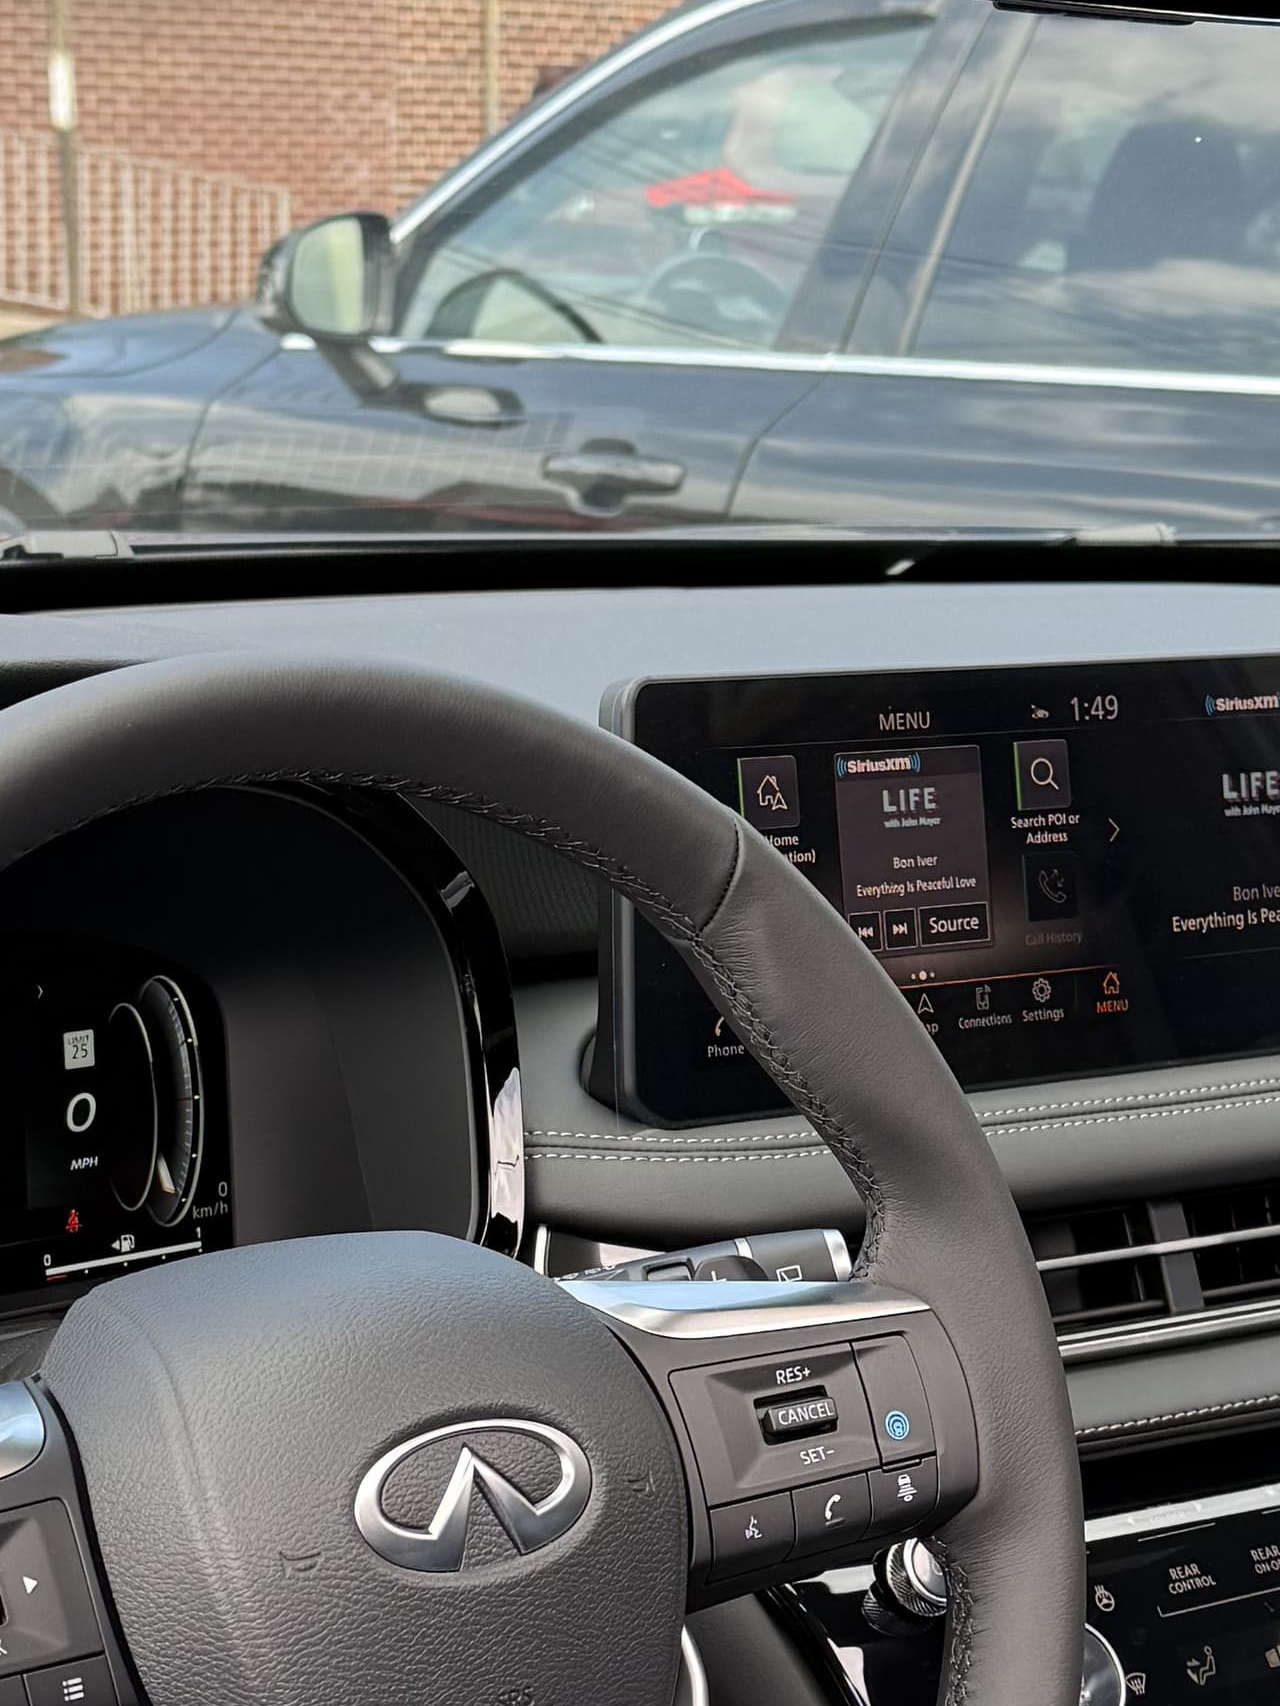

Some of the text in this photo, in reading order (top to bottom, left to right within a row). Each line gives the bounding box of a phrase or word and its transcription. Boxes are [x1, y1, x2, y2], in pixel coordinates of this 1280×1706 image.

[1071, 695, 1119, 722] 1:49
[879, 712, 930, 731] MENU
[883, 788, 936, 813] LIFE
[1224, 806, 1241, 817] with
[1243, 805, 1259, 815] John
[1011, 814, 1080, 829] Search POI or
[1026, 831, 1067, 844] Address
[893, 855, 937, 869] Bon Iver
[857, 877, 976, 898] Everything Is Peaceful Love
[1234, 885, 1259, 901] Bon
[930, 915, 979, 934] Source
[1173, 912, 1244, 933] Everything
[1248, 910, 1257, 924] Is
[1026, 932, 1082, 946] Call History
[959, 1013, 1012, 1029] Connections
[1023, 1008, 1064, 1024] Settings
[1097, 1000, 1128, 1013] MENU
[72, 1045, 88, 1059] 25
[708, 1044, 745, 1058] Phone
[66, 1092, 96, 1132] 0
[71, 1157, 98, 1170] MPH
[218, 1181, 228, 1197] 0
[193, 1202, 228, 1220] km/h
[44, 1254, 51, 1266] 0
[776, 1366, 811, 1384] RES+
[779, 1402, 834, 1425] CANCEL
[1251, 1545, 1280, 1562] REAR
[1170, 1564, 1200, 1580] REAR
[1169, 1575, 1216, 1594] CONTROL
